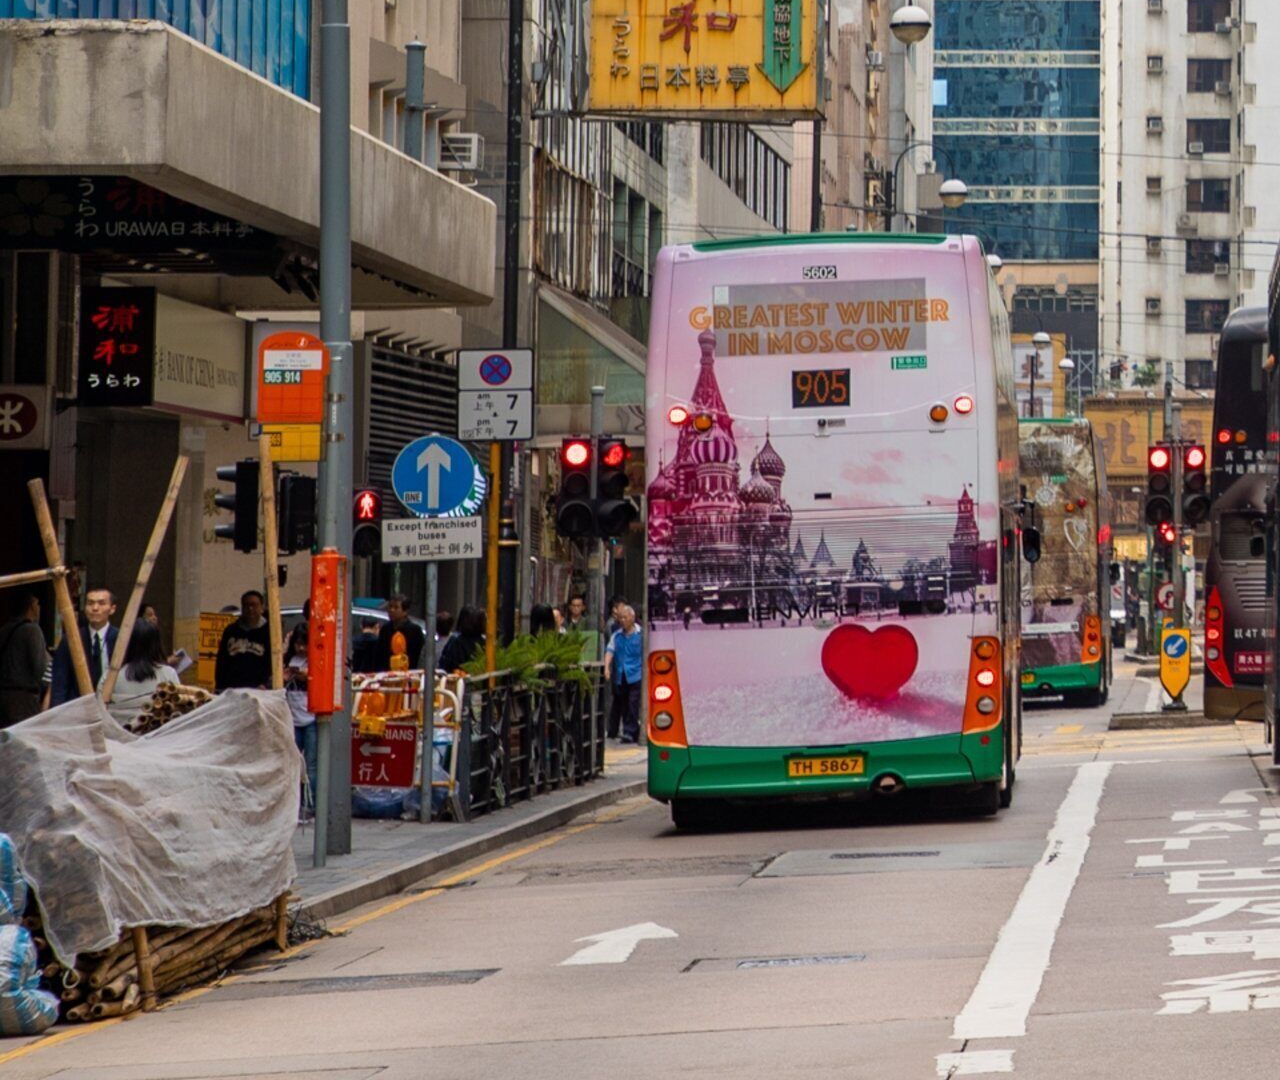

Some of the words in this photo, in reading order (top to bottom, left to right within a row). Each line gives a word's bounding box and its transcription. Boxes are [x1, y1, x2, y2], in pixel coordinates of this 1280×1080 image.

[640, 63, 752, 93] 日本料亭
[75, 177, 99, 238] うらわ
[106, 222, 169, 236] URAWA
[802, 266, 838, 280] 5602
[688, 303, 830, 331] GREATEST
[836, 298, 950, 326] WINTER
[91, 304, 140, 366] 浦和
[727, 332, 759, 356] IN
[766, 327, 911, 355] MOSCOW
[87, 373, 141, 388] うらわ
[265, 370, 282, 383] 905
[284, 370, 300, 383] 914
[795, 370, 847, 404] 905
[474, 401, 494, 411] 上午
[507, 394, 518, 410] 7
[476, 419, 490, 427] pm
[506, 420, 518, 436] 7
[475, 427, 495, 437] 下午
[386, 521, 422, 532] Except
[424, 520, 477, 530] franchised
[417, 531, 446, 541] buses
[390, 542, 474, 557] 專利巴士例外
[358, 762, 390, 782] 行人
[793, 760, 814, 775] TH
[820, 758, 860, 774] 5867
